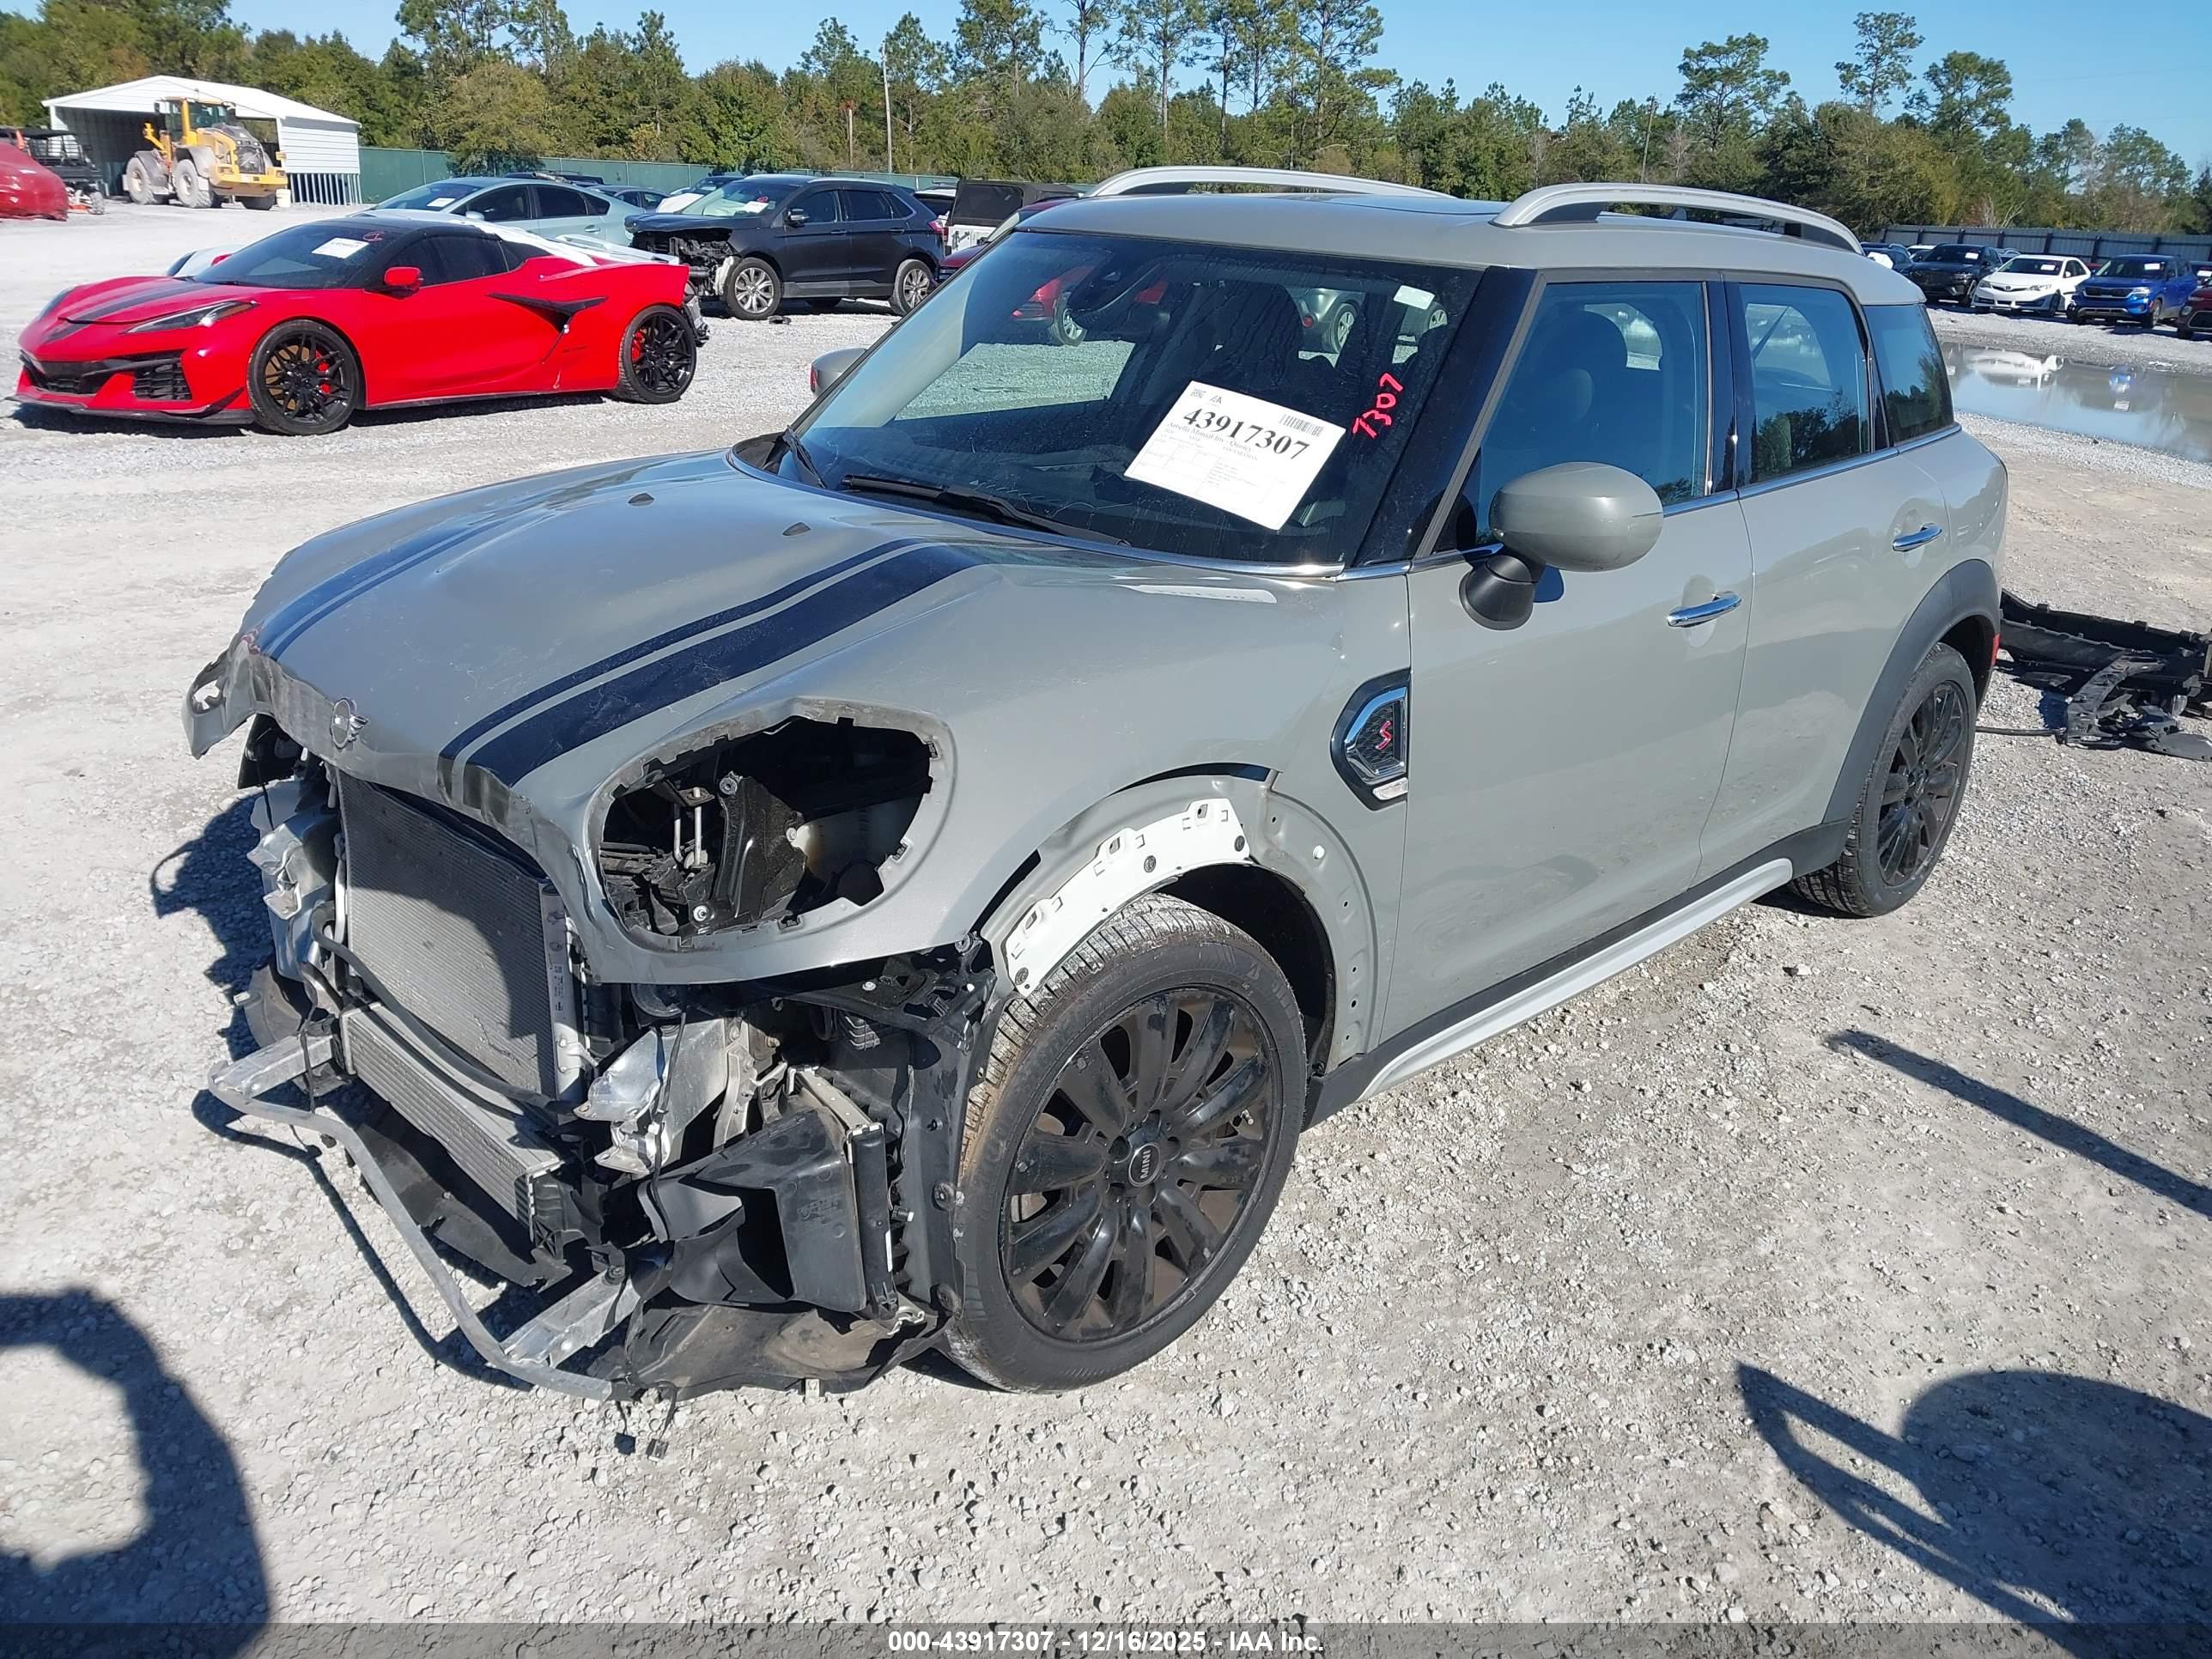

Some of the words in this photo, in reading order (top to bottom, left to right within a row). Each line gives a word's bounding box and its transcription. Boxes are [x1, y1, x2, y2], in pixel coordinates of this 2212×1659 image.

[1352, 373, 1403, 439] 7307
[1183, 408, 1310, 459] 43917307
[1376, 720, 1392, 750] S
[1139, 1150, 1152, 1179] MINI
